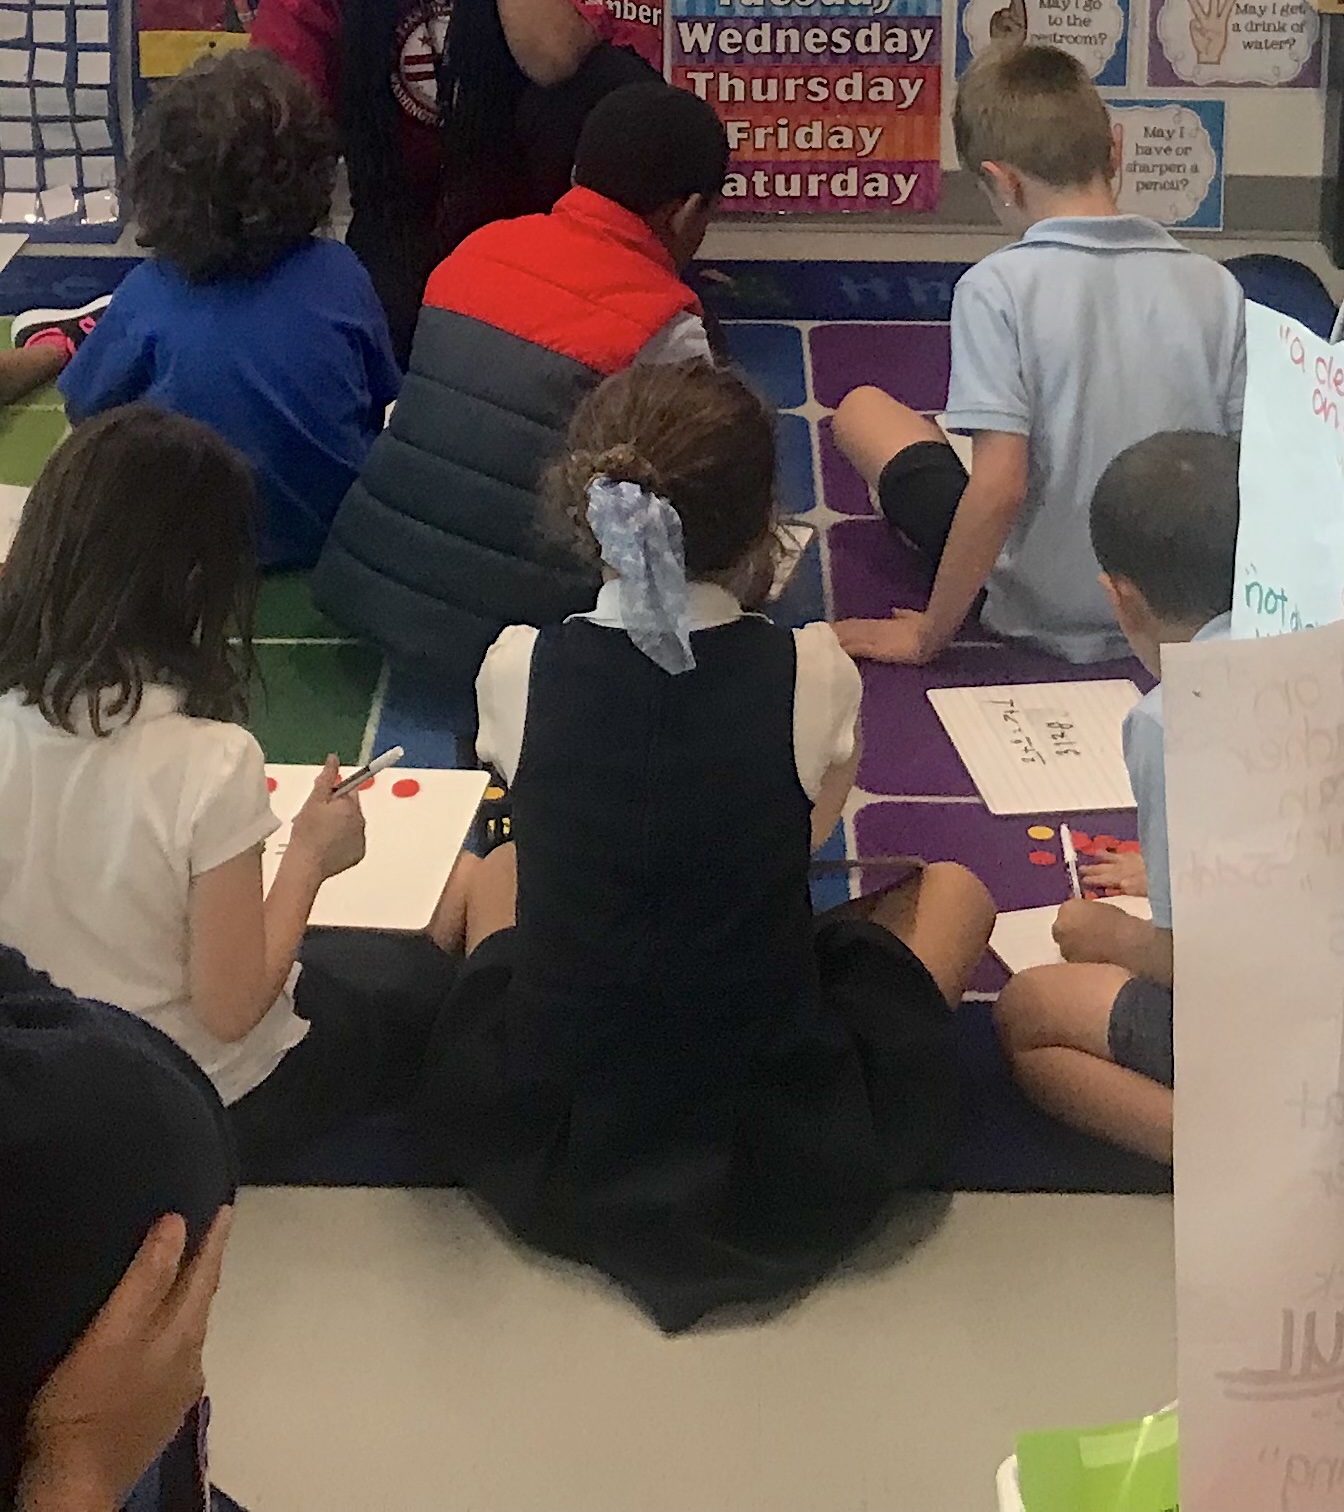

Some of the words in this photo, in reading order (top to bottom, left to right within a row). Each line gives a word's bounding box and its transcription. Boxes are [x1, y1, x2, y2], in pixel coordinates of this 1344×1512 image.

[1235, 2, 1266, 18] May
[1282, 4, 1305, 18] get
[1048, 15, 1064, 27] to
[1067, 13, 1092, 27] the
[1244, 19, 1288, 33] drink
[1291, 20, 1306, 33] of
[676, 21, 935, 61] Wednesday
[1242, 37, 1296, 51] water?
[686, 71, 925, 109] Thursday
[725, 118, 883, 157] Friday
[1143, 126, 1175, 141] May
[1135, 142, 1172, 156] have
[1175, 146, 1193, 156] or
[1125, 161, 1188, 176] sharpen
[721, 167, 919, 204] aturday
[1245, 580, 1288, 617] not
